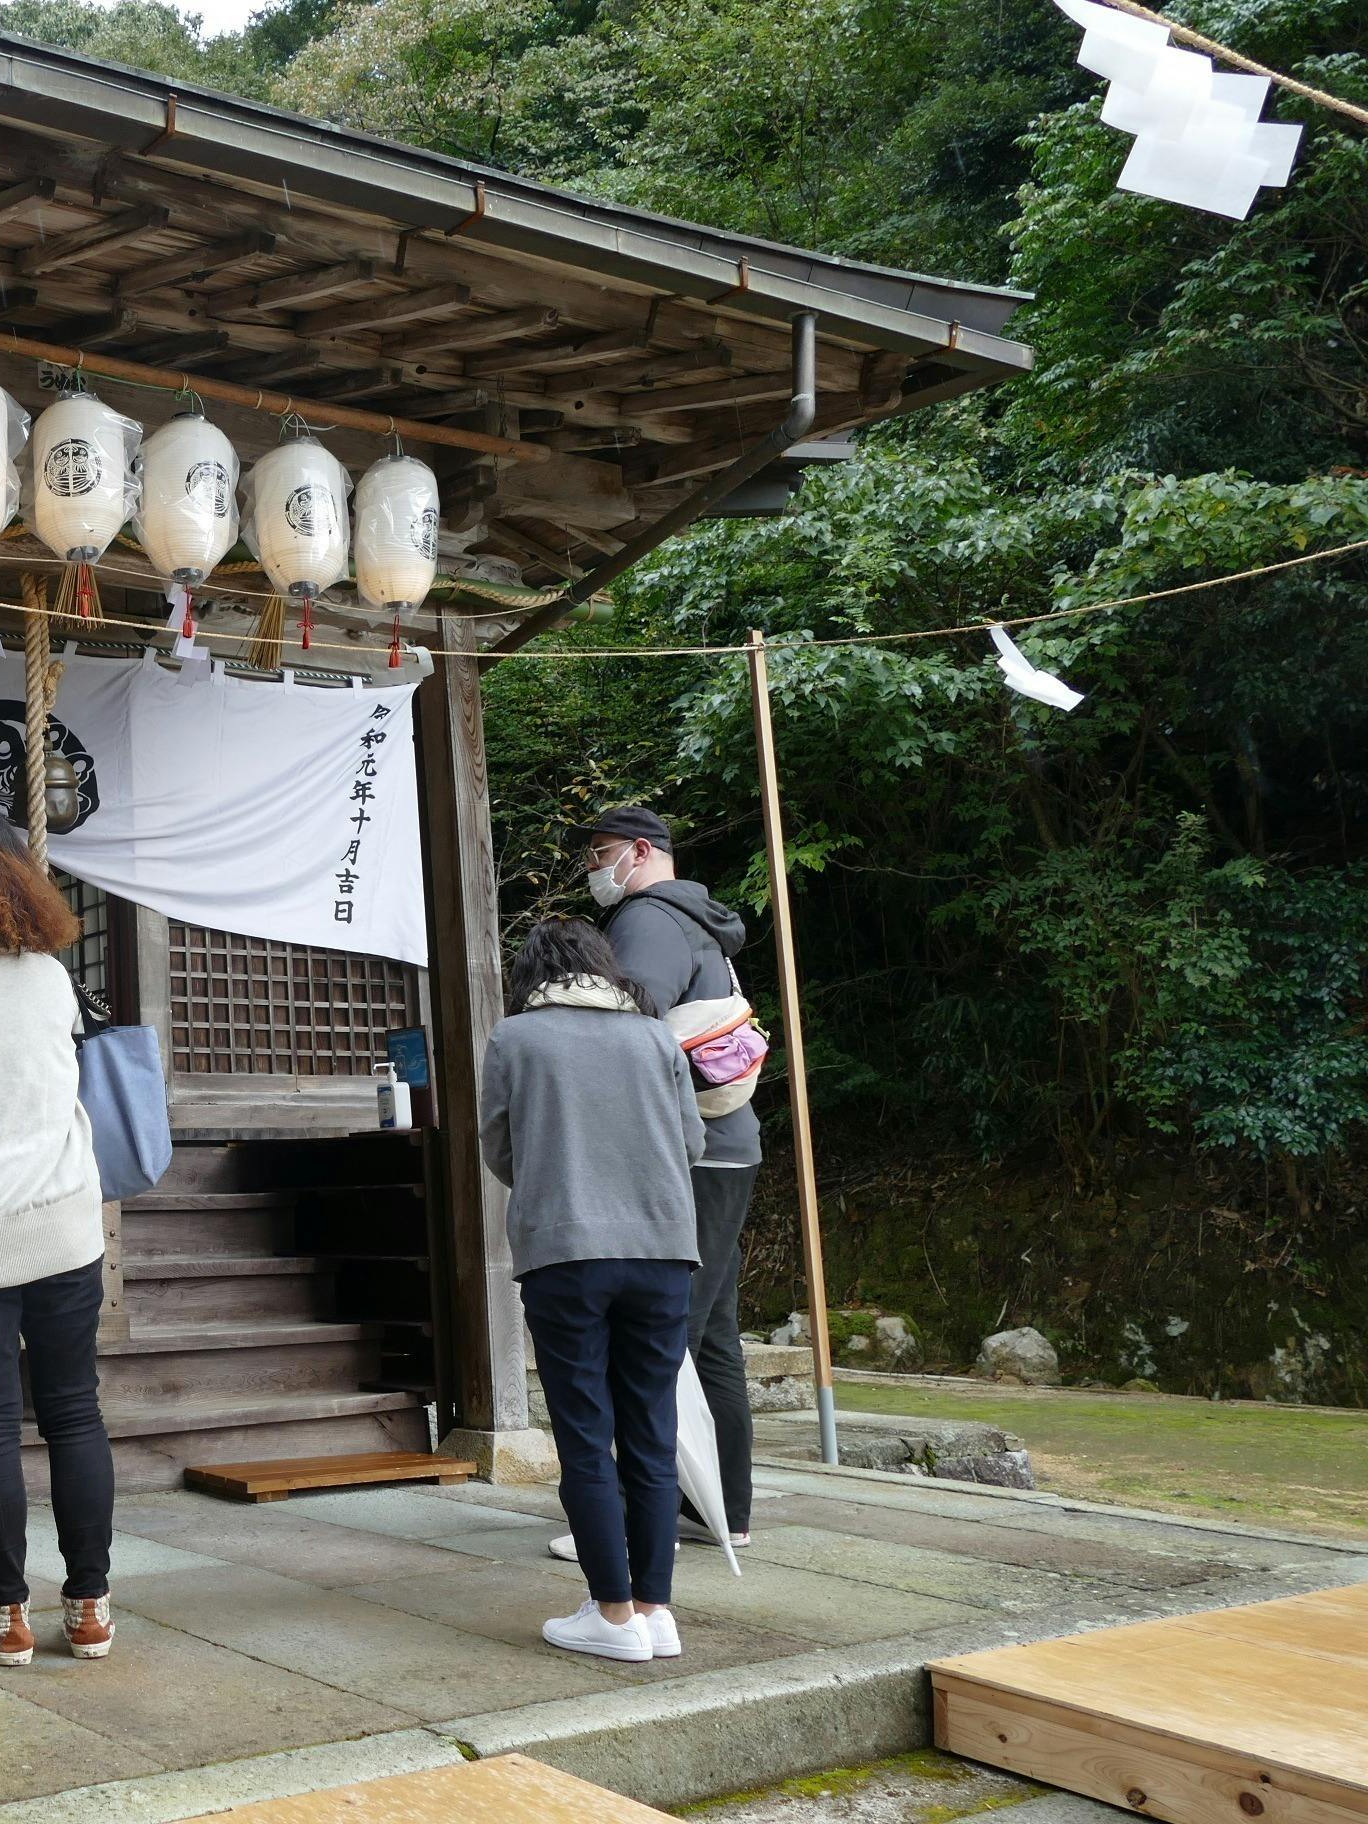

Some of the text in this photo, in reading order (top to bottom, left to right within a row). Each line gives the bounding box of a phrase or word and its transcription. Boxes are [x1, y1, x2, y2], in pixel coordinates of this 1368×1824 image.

[334, 703, 392, 924] 令和元年十月吉日
